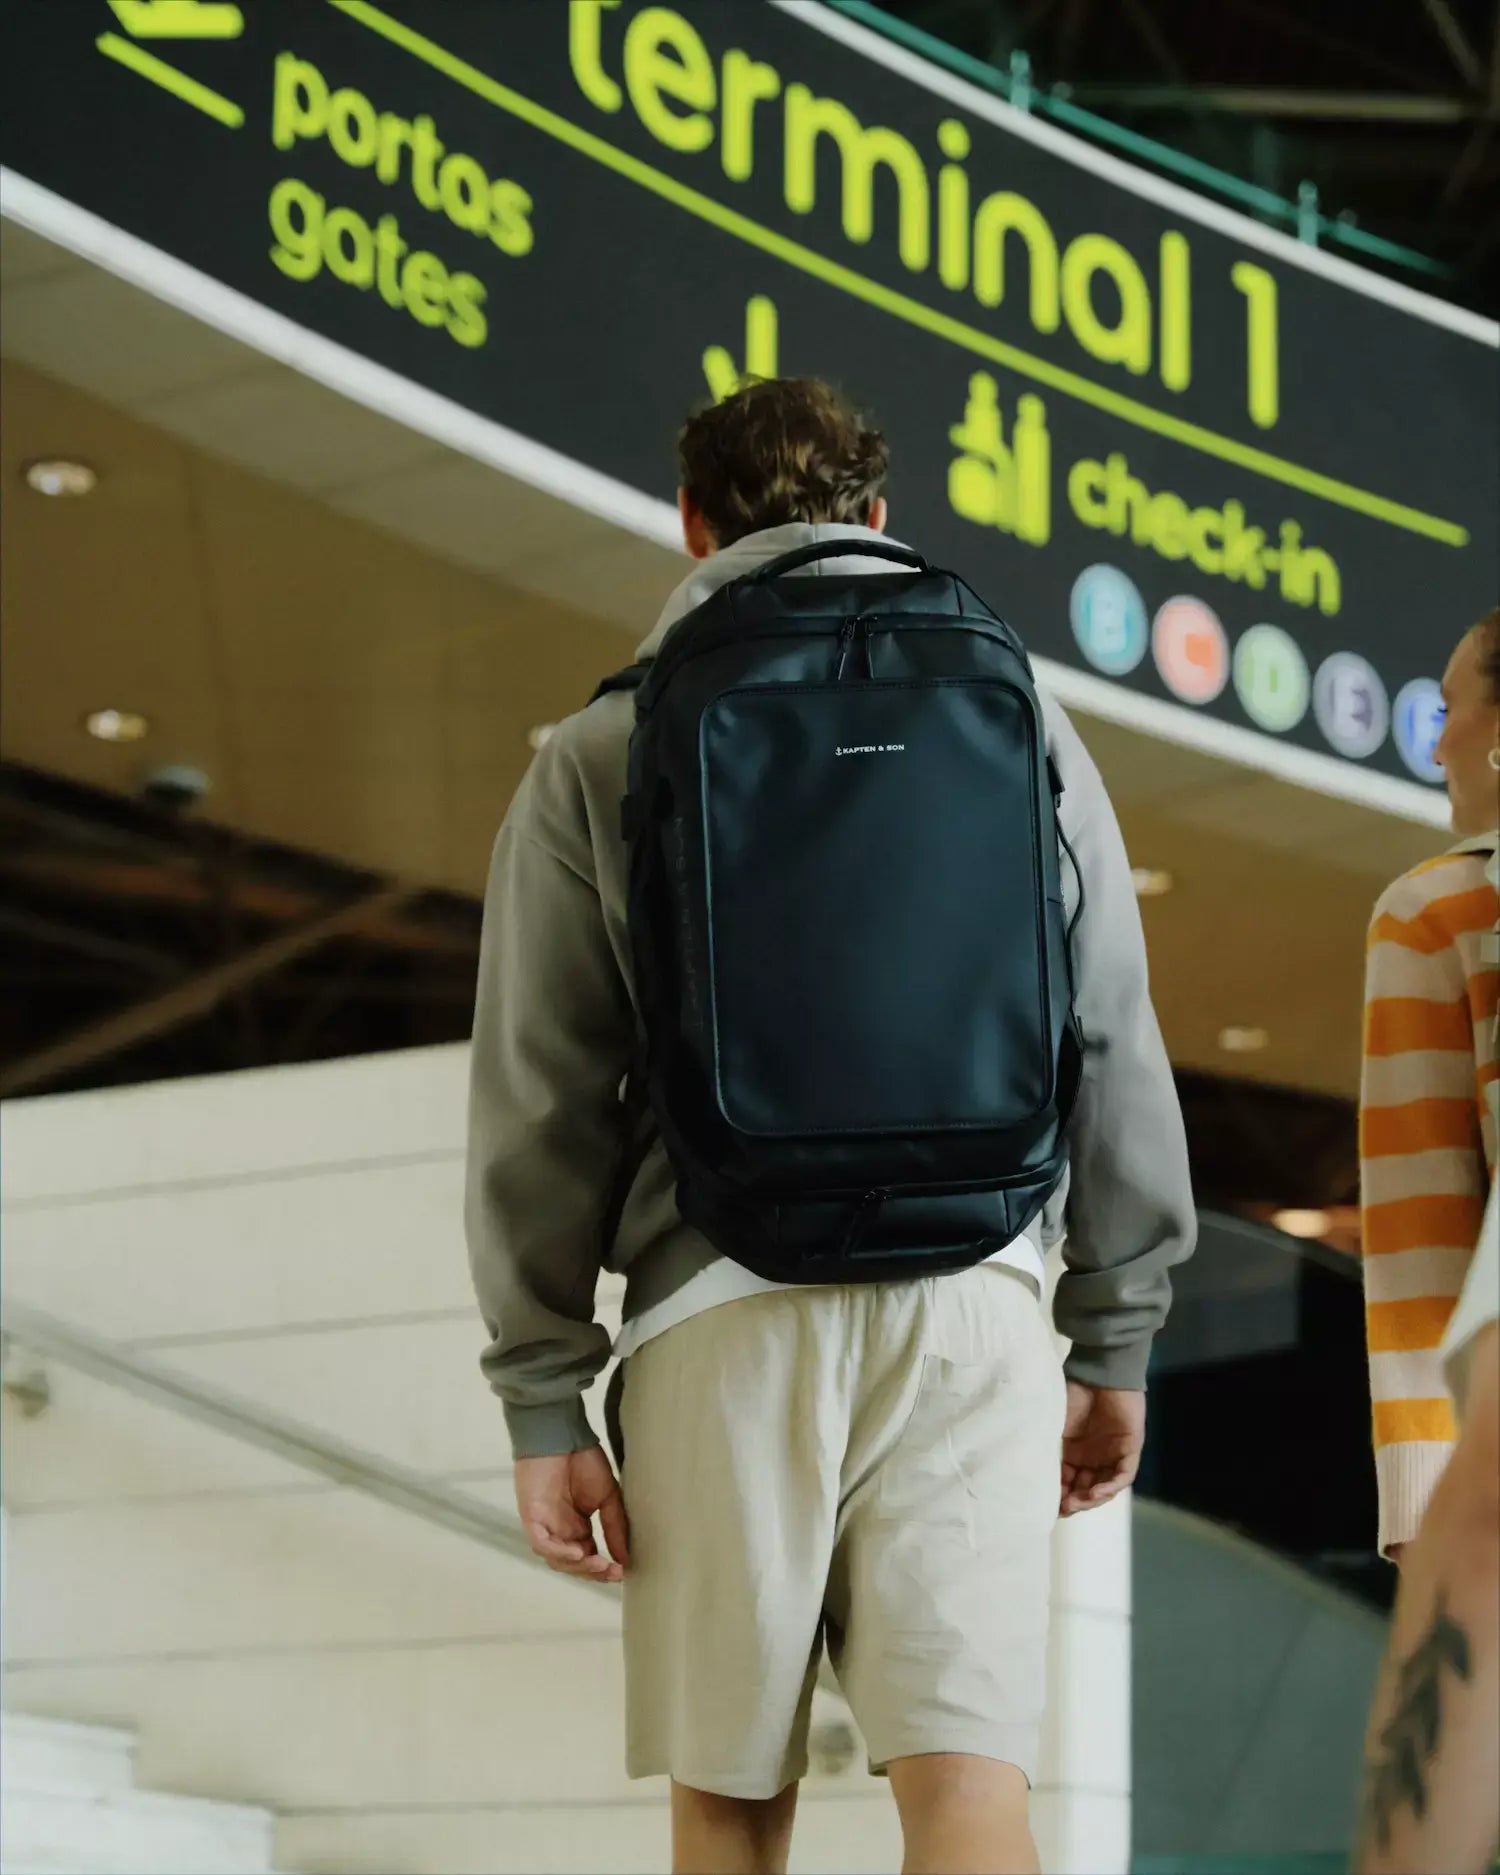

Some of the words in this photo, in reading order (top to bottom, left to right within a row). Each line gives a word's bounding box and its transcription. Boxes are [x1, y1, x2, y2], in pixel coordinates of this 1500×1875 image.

[272, 52, 534, 257] portas
[568, 0, 1192, 391] terminal
[1231, 261, 1279, 430] 1
[268, 178, 488, 348] gates
[1067, 452, 1342, 615] check-in
[842, 745, 877, 755] KAPTEN
[886, 743, 905, 752] SON
